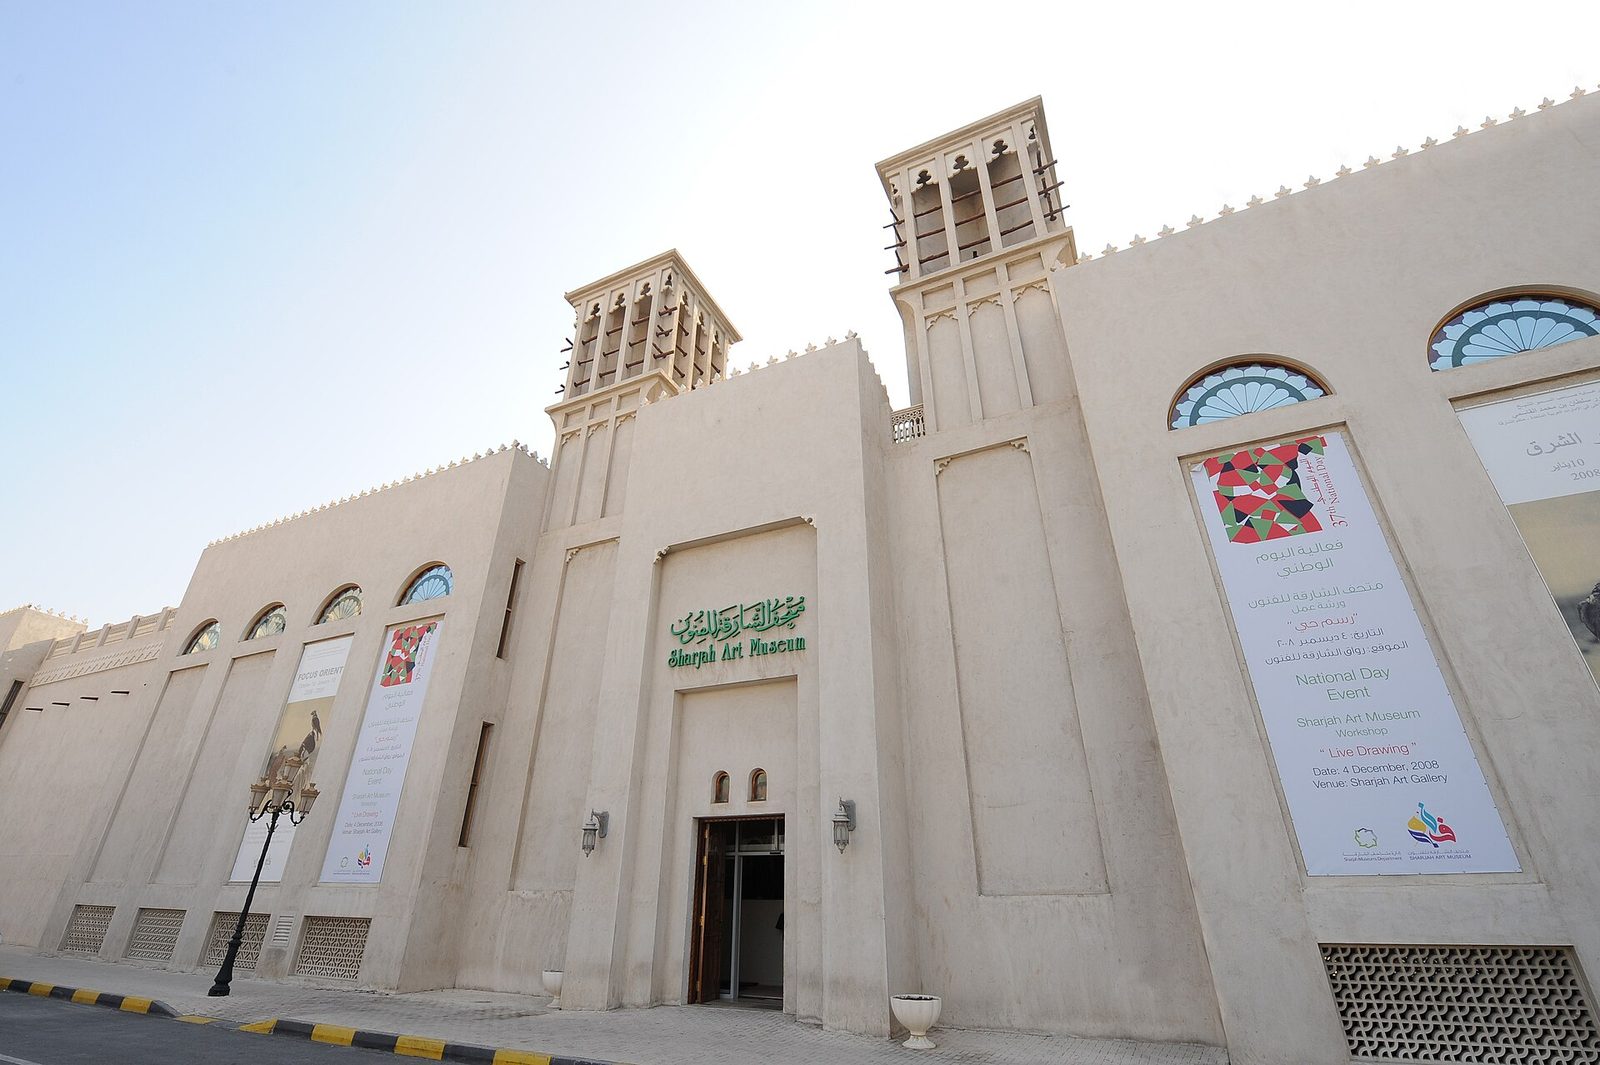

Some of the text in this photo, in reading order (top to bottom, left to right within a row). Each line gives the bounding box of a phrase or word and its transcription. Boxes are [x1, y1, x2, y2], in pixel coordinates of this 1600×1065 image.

[1526, 431, 1582, 457] الشرق
[1315, 455, 1326, 472] Day
[1319, 472, 1340, 505] National
[1255, 539, 1344, 565] فعالية اليوم
[1276, 557, 1334, 579] الوطني
[1248, 580, 1384, 609] متحف الشارقة للفنون
[1291, 604, 1316, 615] عمل
[1299, 634, 1340, 647] ديسمبر
[667, 636, 806, 669] Sharjah Art Museum
[1264, 653, 1300, 666] للفنون
[1302, 648, 1342, 660] الشارقة
[297, 665, 344, 681] FOCUS ORIENT
[1295, 667, 1390, 686] National Day
[1326, 686, 1371, 701] Event
[1296, 709, 1421, 728] Sharjah Art Museum
[1335, 726, 1389, 738] Workshop
[1328, 745, 1354, 758] Live
[1356, 743, 1410, 757] Drawing
[1312, 759, 1440, 777] Date: 4 December, 2008
[1312, 773, 1448, 789] Venue: Sharjah Art Gallery
